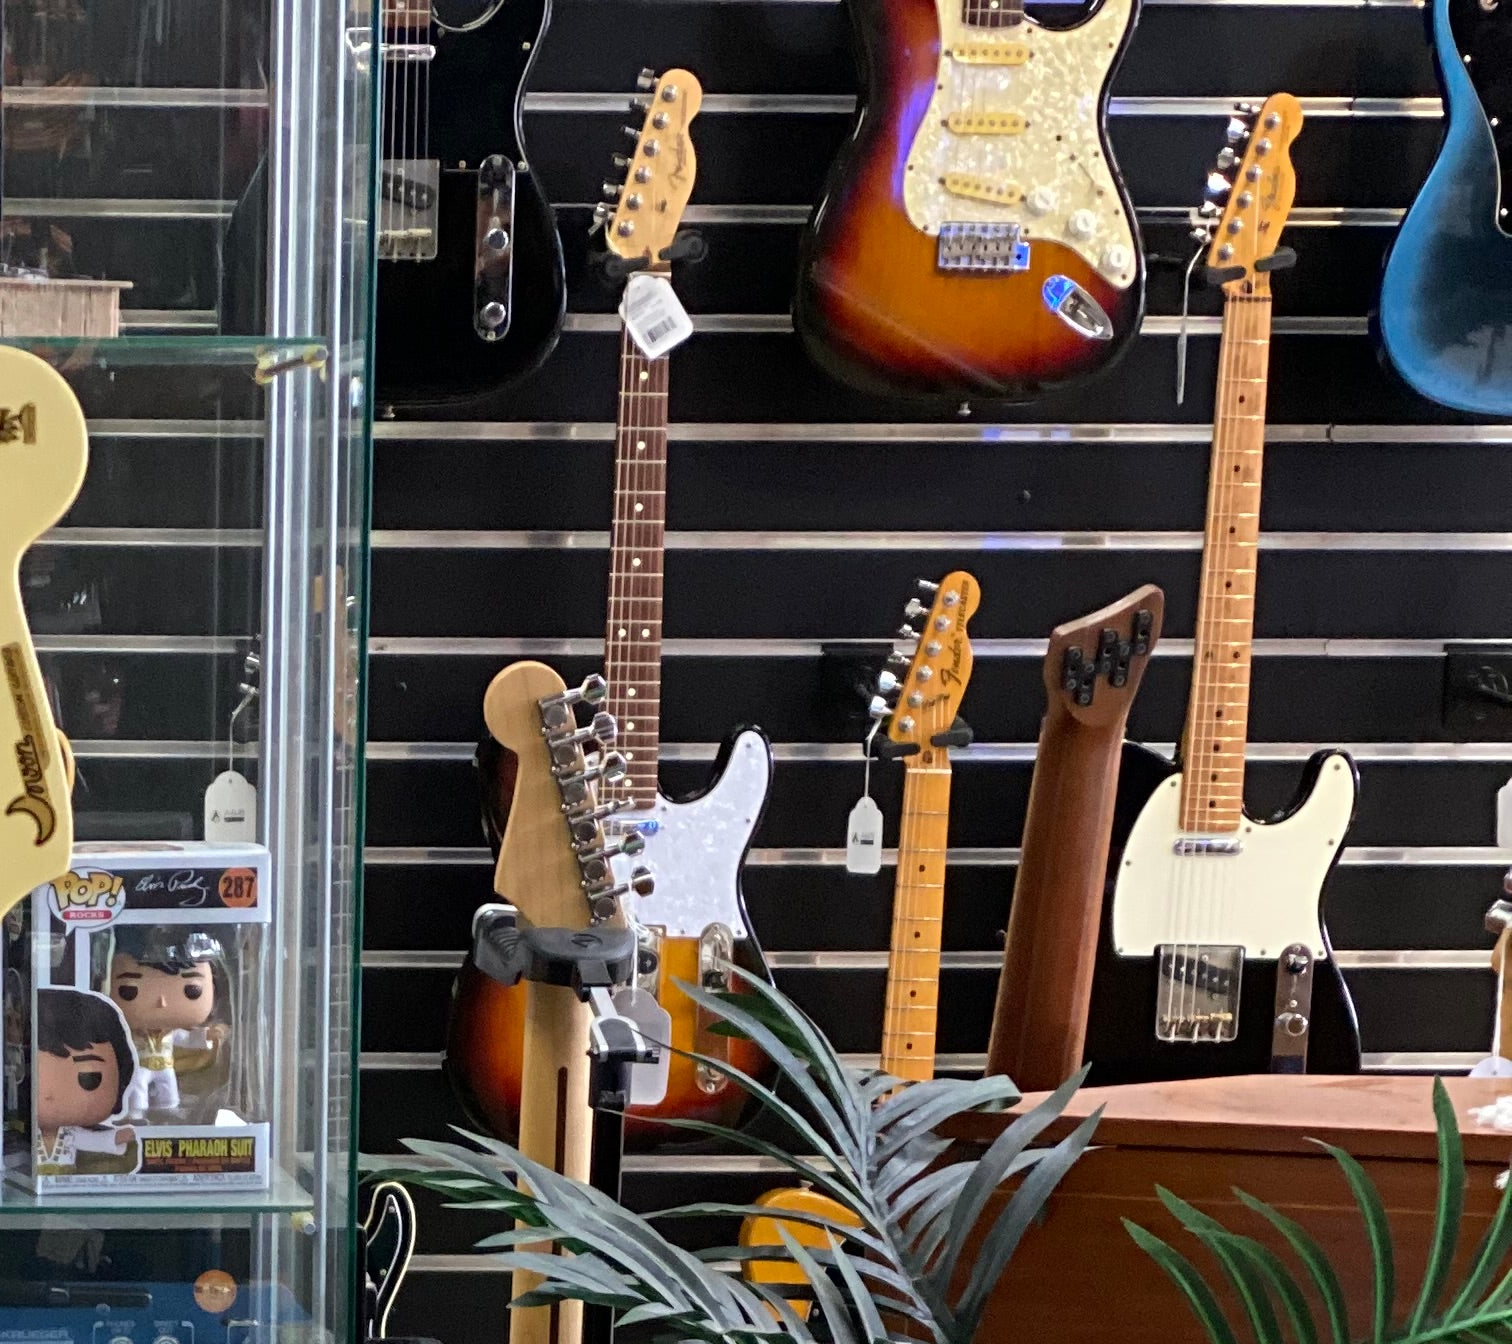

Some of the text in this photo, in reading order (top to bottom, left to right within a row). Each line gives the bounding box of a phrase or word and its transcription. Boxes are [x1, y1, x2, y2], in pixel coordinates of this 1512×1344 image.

[941, 638, 963, 687] Fender
[51, 871, 124, 911] POP!
[222, 875, 255, 898] 287
[69, 911, 105, 919] ROCKS
[145, 1138, 254, 1158] ELVIS PHARAOH SUIT
